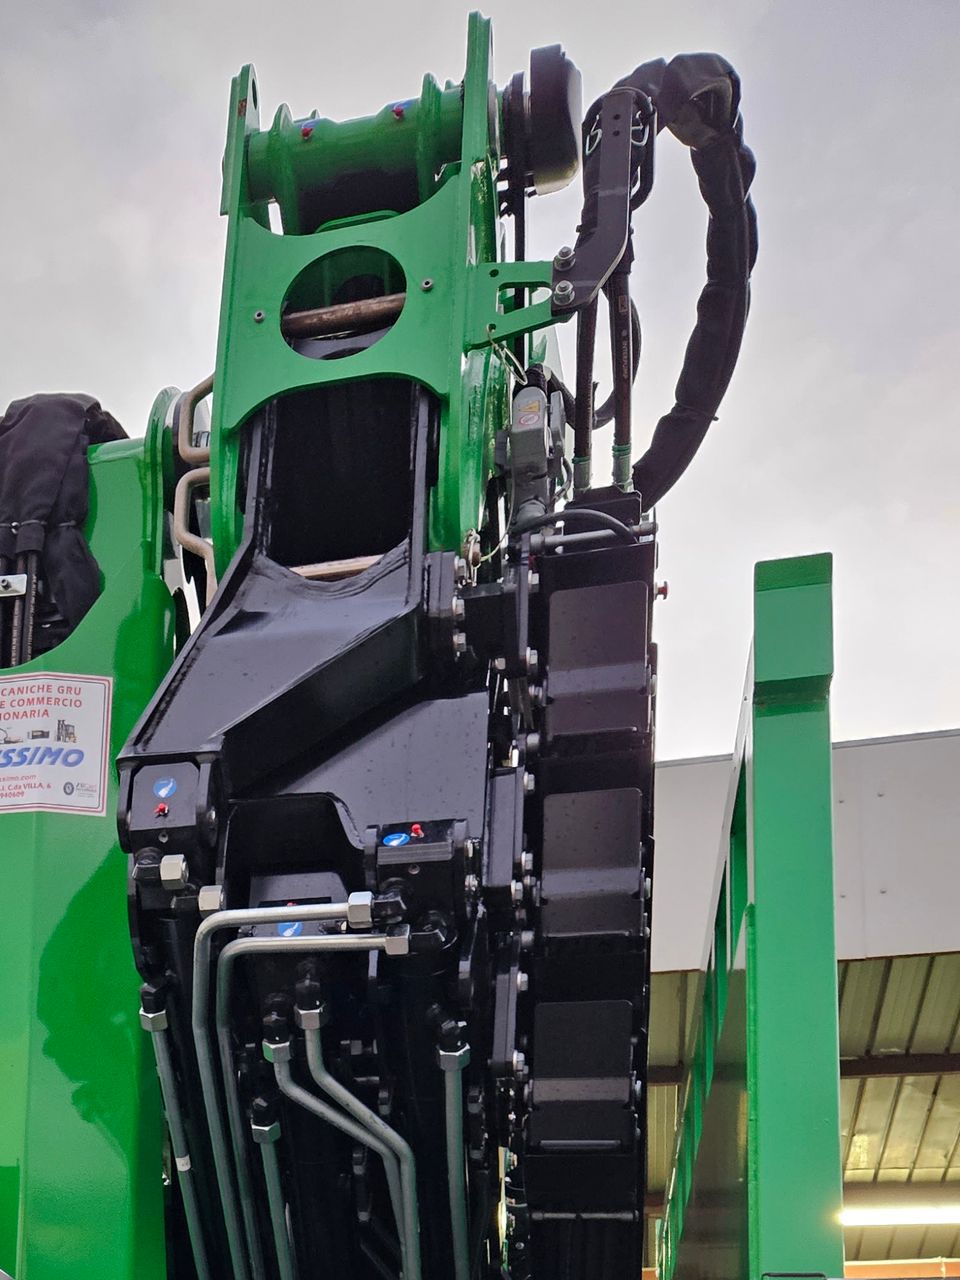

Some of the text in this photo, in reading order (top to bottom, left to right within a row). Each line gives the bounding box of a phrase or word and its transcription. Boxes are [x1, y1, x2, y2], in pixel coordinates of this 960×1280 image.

[57, 685, 82, 697] GRU
[0, 700, 6, 709] E
[10, 696, 83, 708] COMMERCIO
